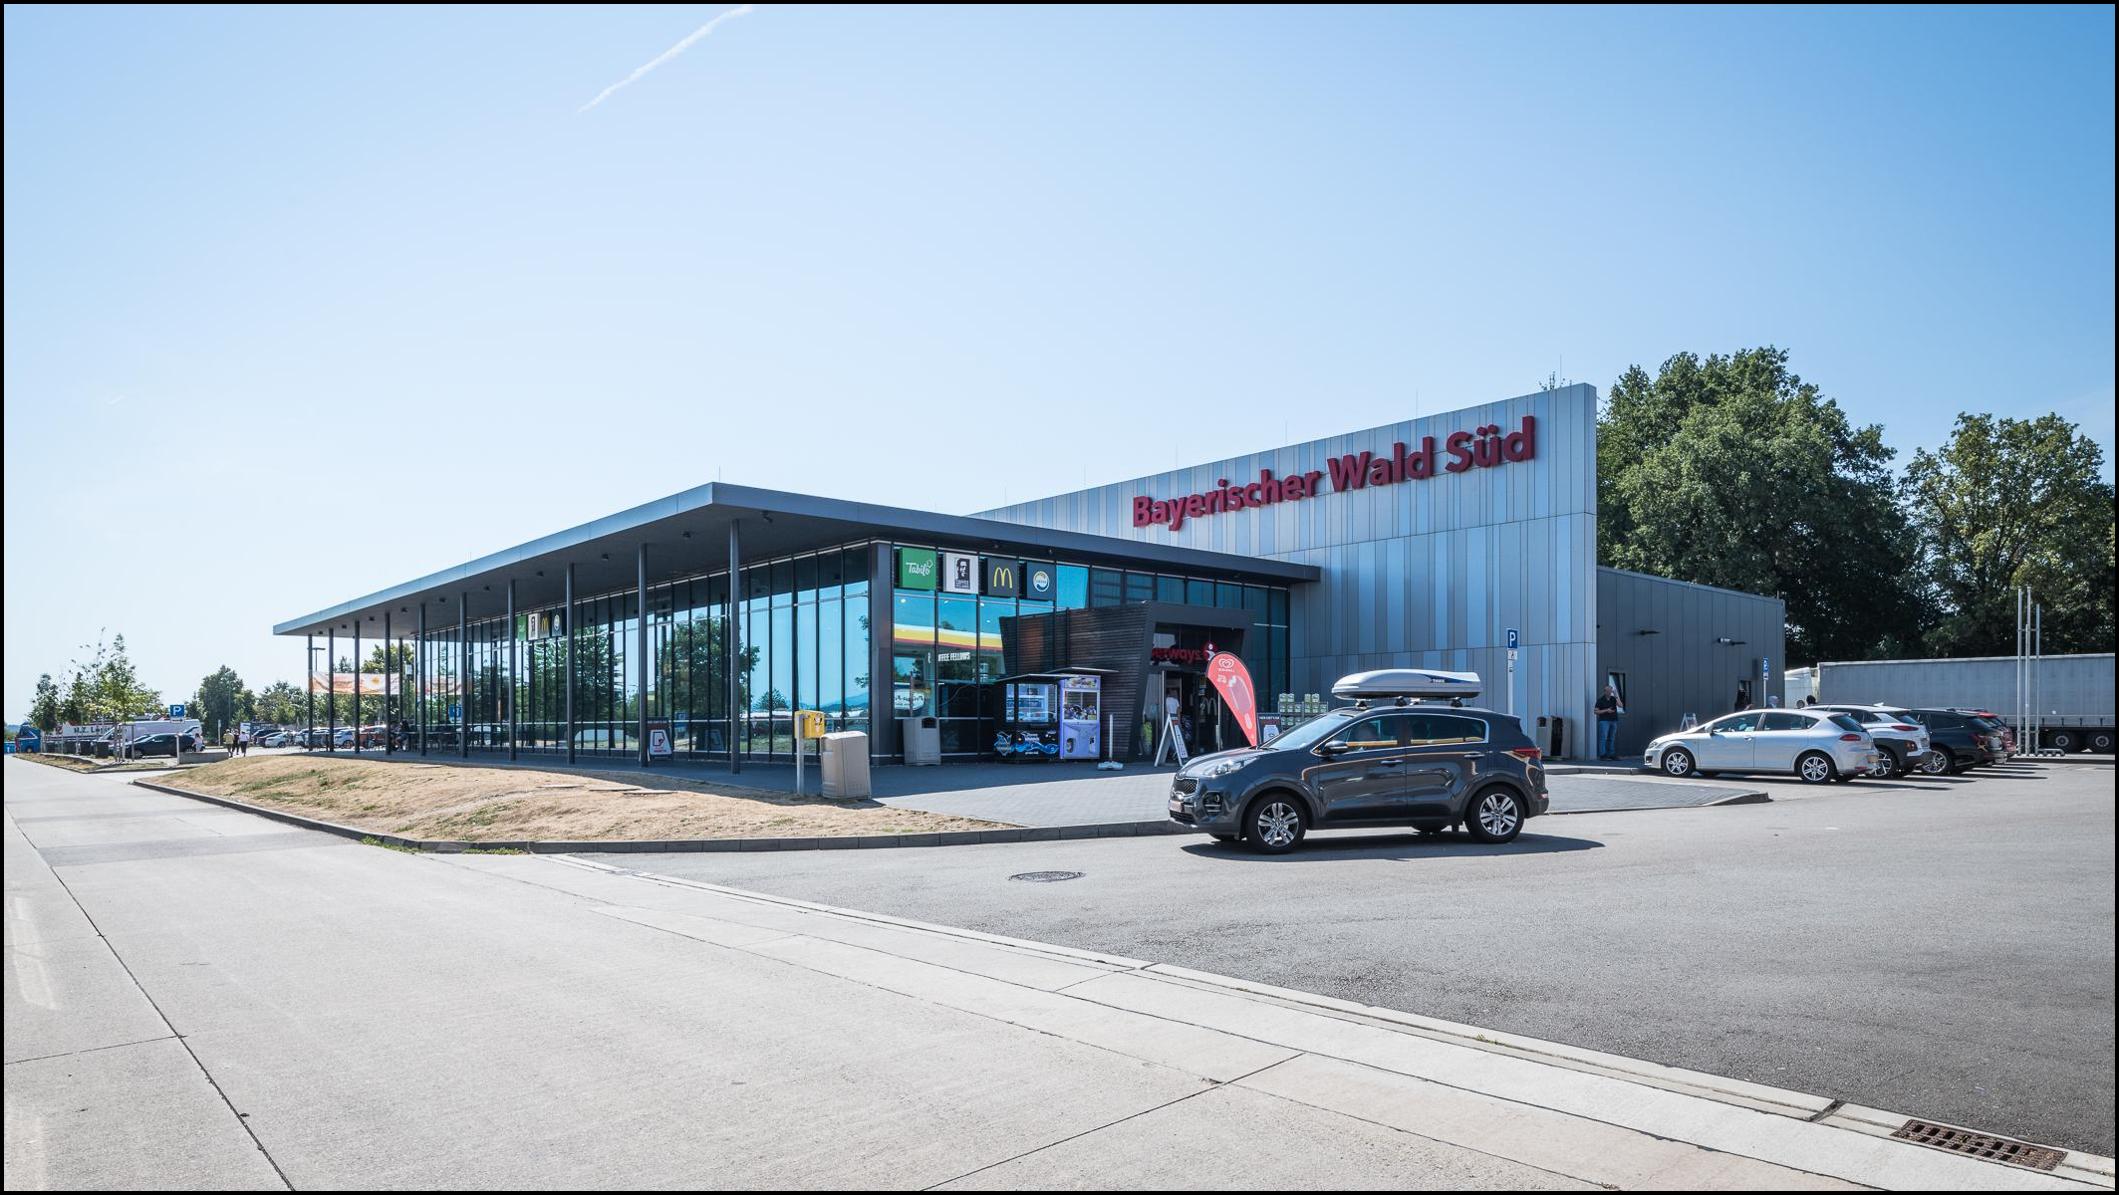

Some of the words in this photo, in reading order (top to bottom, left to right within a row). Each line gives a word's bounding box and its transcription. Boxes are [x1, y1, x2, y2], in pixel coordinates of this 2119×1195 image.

[1133, 468, 1321, 532] Bayerischer
[1327, 436, 1435, 493] Wald
[1445, 415, 1536, 474] Süd
[1509, 631, 1516, 648] P
[173, 706, 182, 716] P
